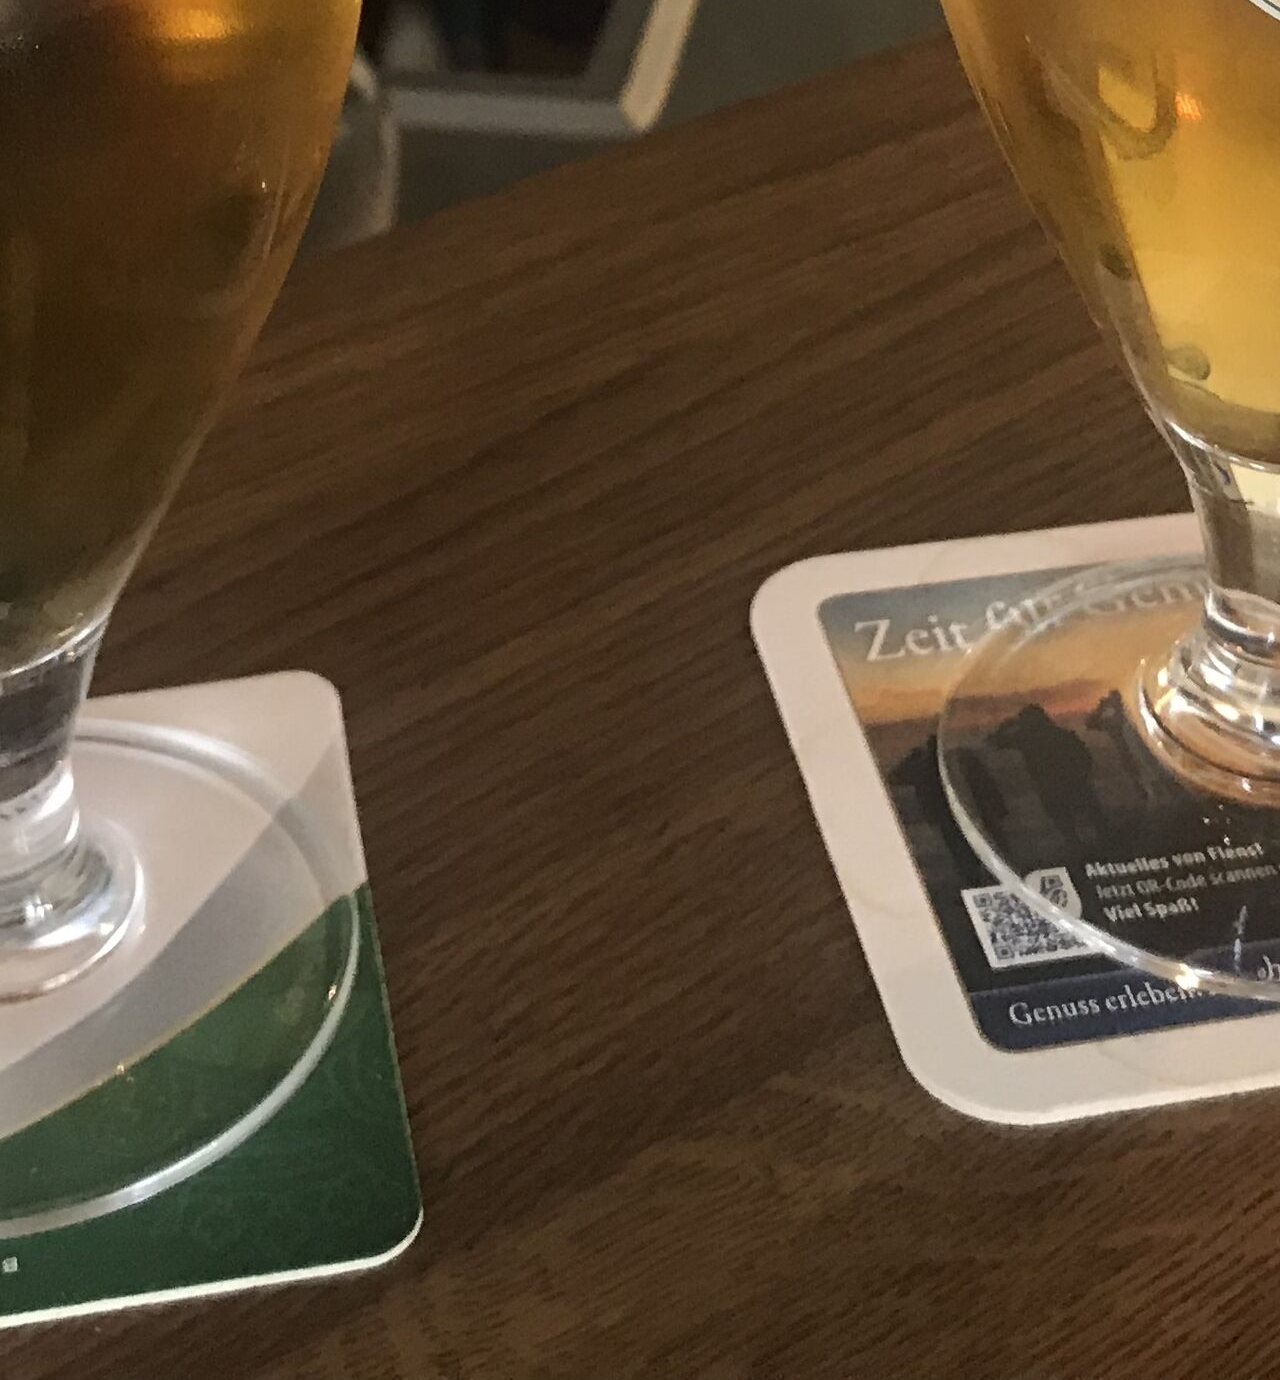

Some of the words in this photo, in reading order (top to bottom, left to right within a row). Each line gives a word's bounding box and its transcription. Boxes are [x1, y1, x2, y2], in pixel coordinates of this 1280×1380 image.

[853, 613, 971, 662] Zeit
[1171, 850, 1206, 868] von
[1103, 901, 1143, 923] Viel
[1008, 996, 1101, 1027] Genuss
